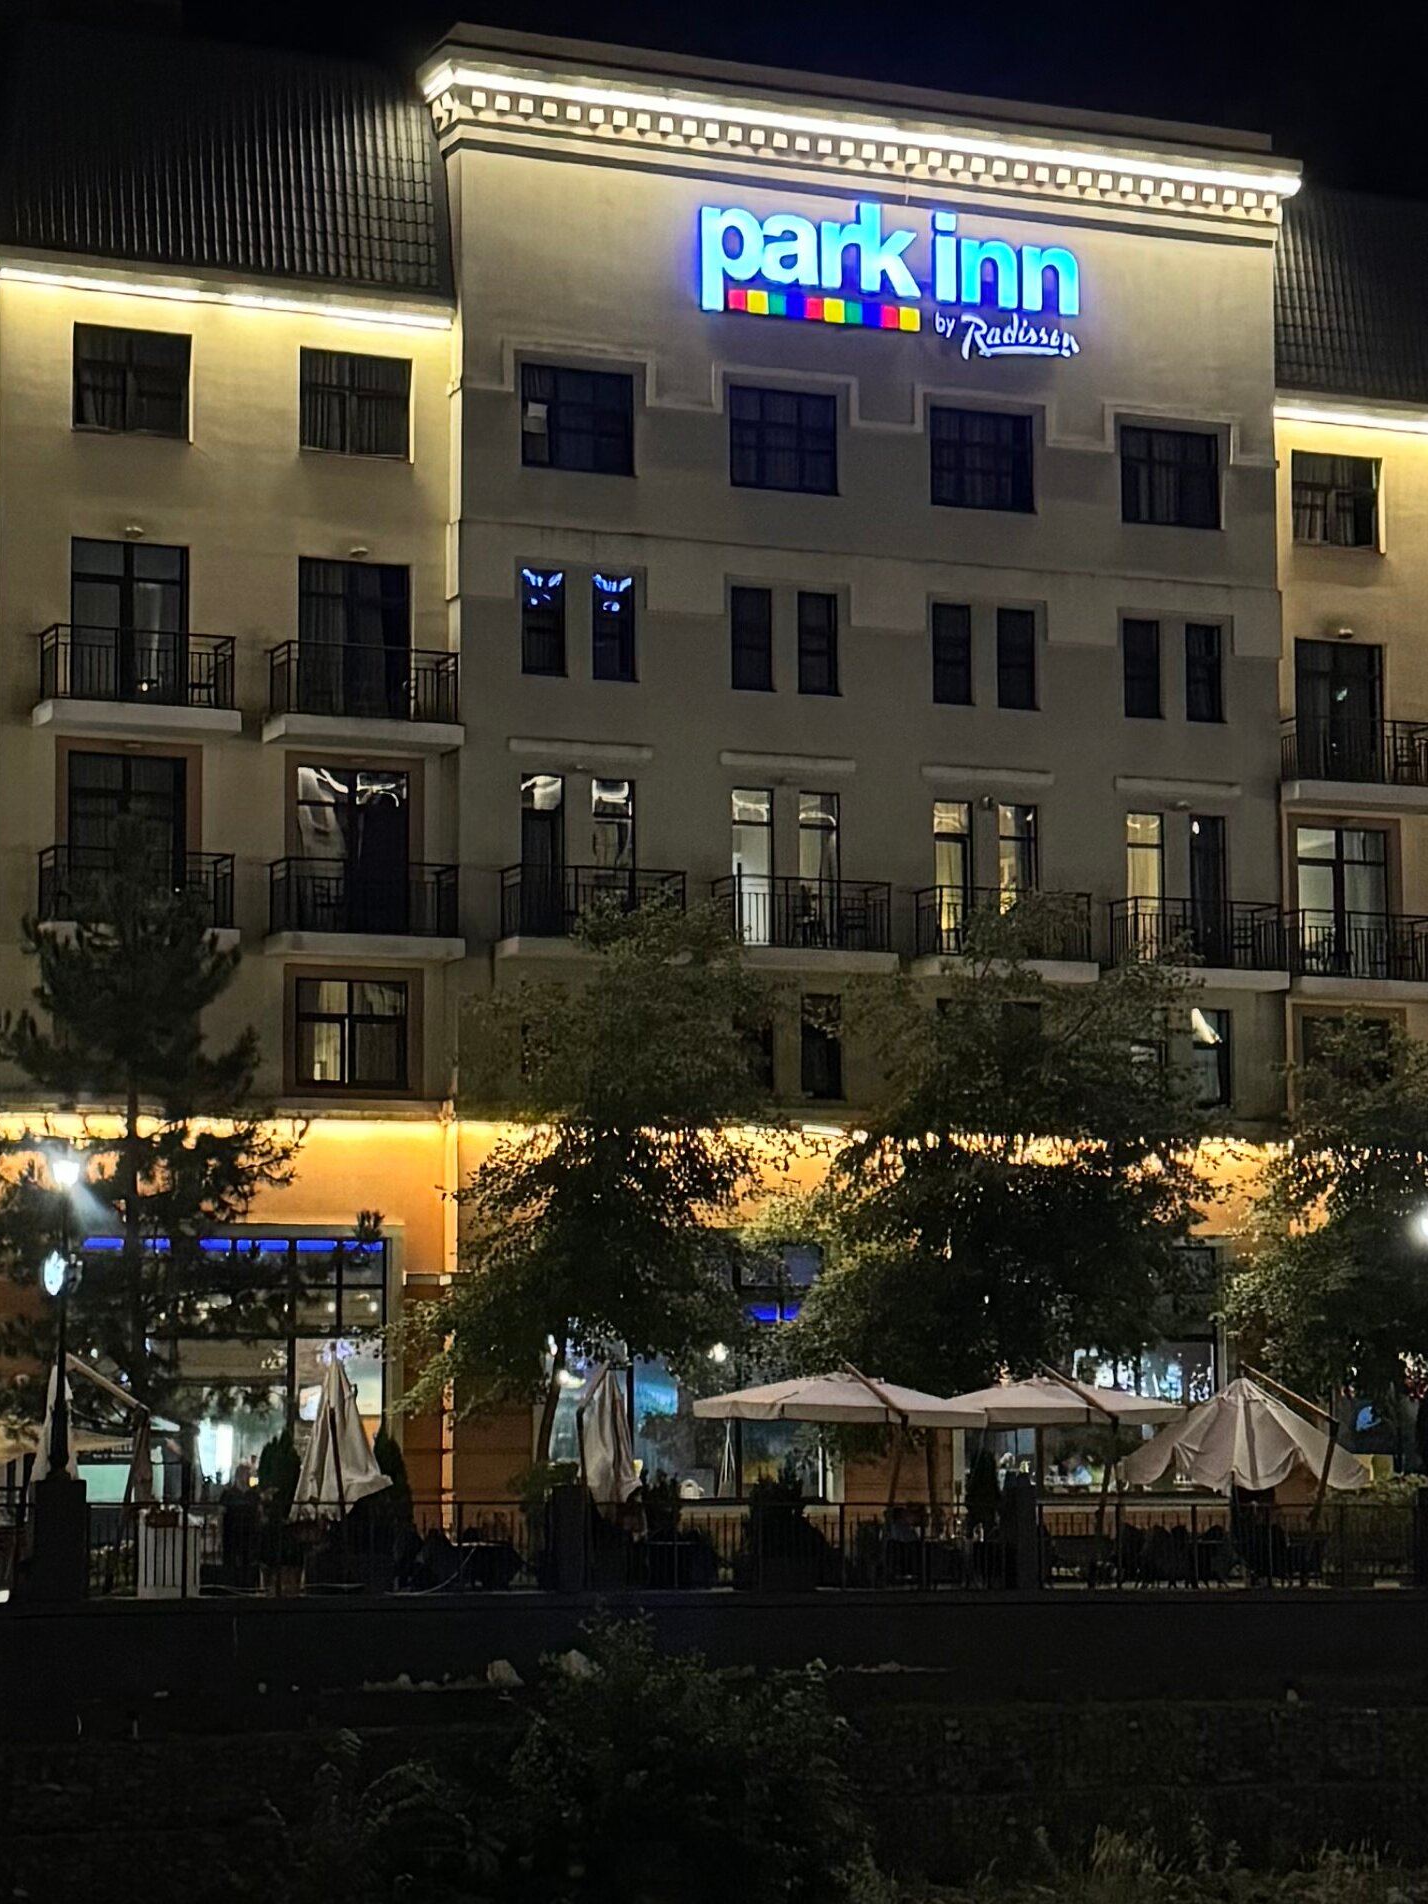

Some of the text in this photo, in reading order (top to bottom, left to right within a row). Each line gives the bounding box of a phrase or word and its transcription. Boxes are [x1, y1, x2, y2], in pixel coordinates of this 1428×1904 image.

[701, 202, 1079, 316] park inn
[934, 310, 1081, 361] by Radisson
